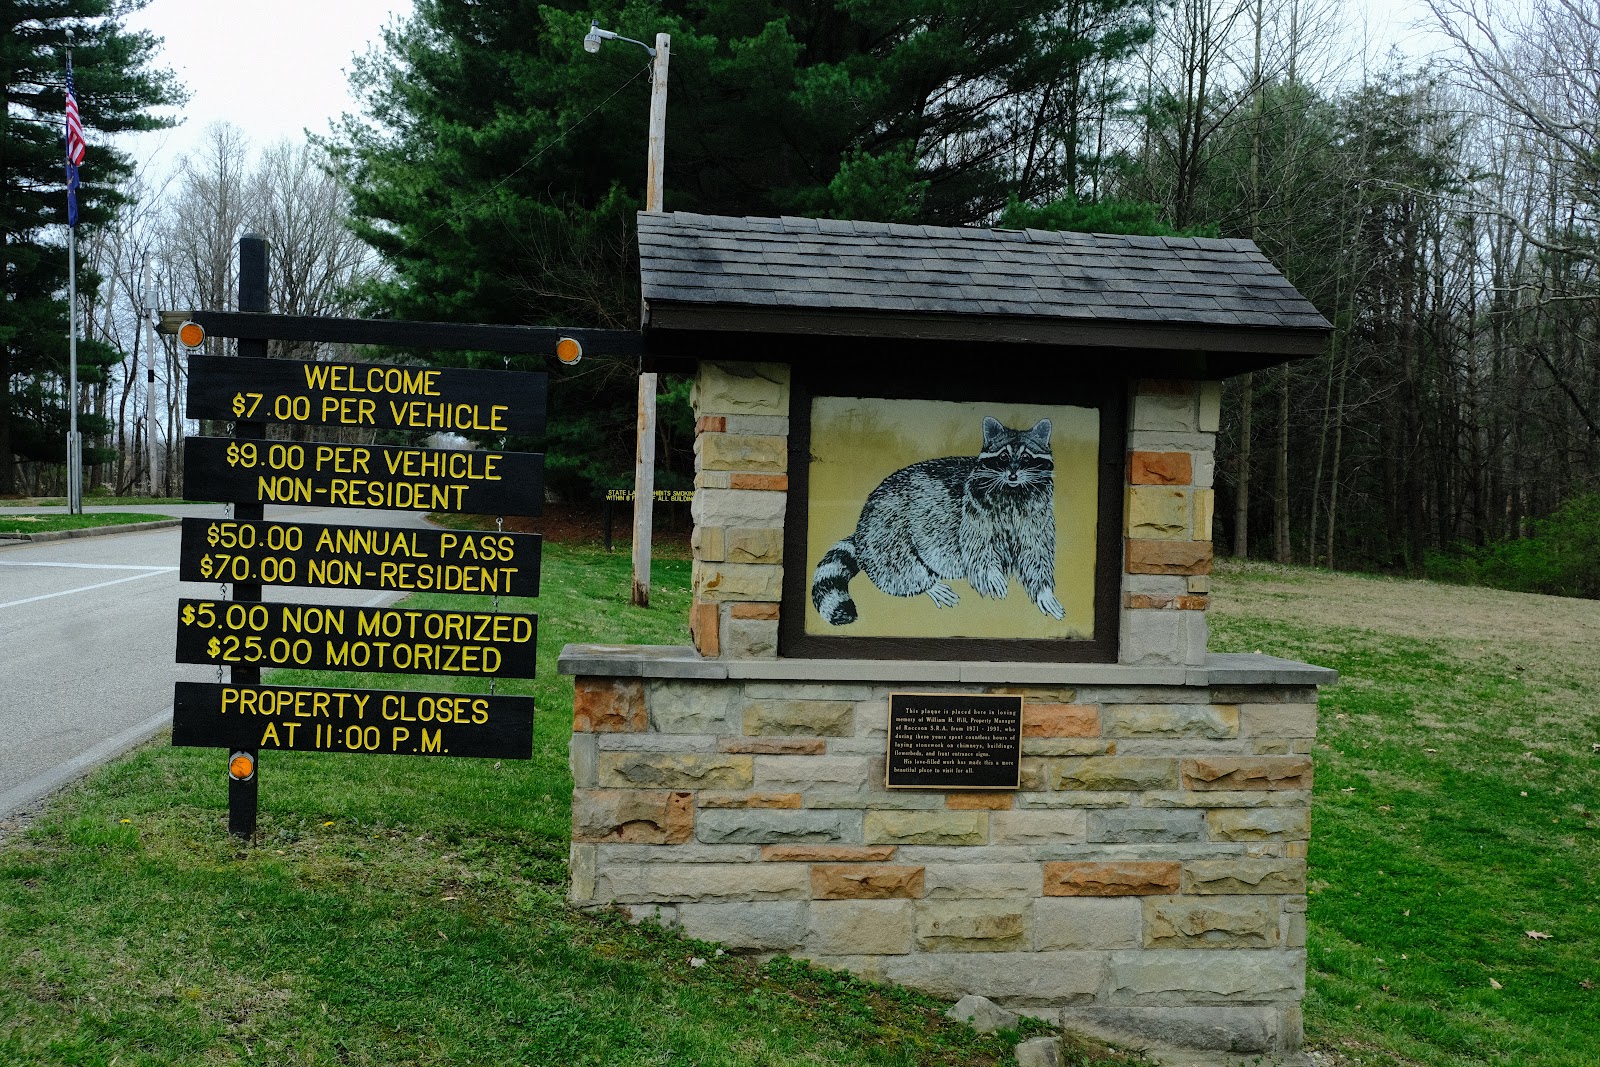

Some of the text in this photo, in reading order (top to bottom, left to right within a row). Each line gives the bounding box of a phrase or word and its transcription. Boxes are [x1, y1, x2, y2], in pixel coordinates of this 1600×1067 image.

[304, 364, 441, 395] WELCOME
[232, 393, 509, 431] $7.00 PER VEHICLE
[226, 442, 503, 480] $9.00 PER VEHICLE
[258, 476, 469, 510] NON-RESIDENT
[207, 523, 514, 561] $50.00 ANNUAL PASS
[200, 554, 518, 592] $70.00 NON-RESIDENT
[181, 603, 532, 642] $5.00 NON MOTORIZED
[207, 635, 501, 673] $25.00 MOTORIZED
[221, 689, 489, 724] PROPERTY CLOSES
[261, 722, 449, 753] AT 11:00 P.M.
